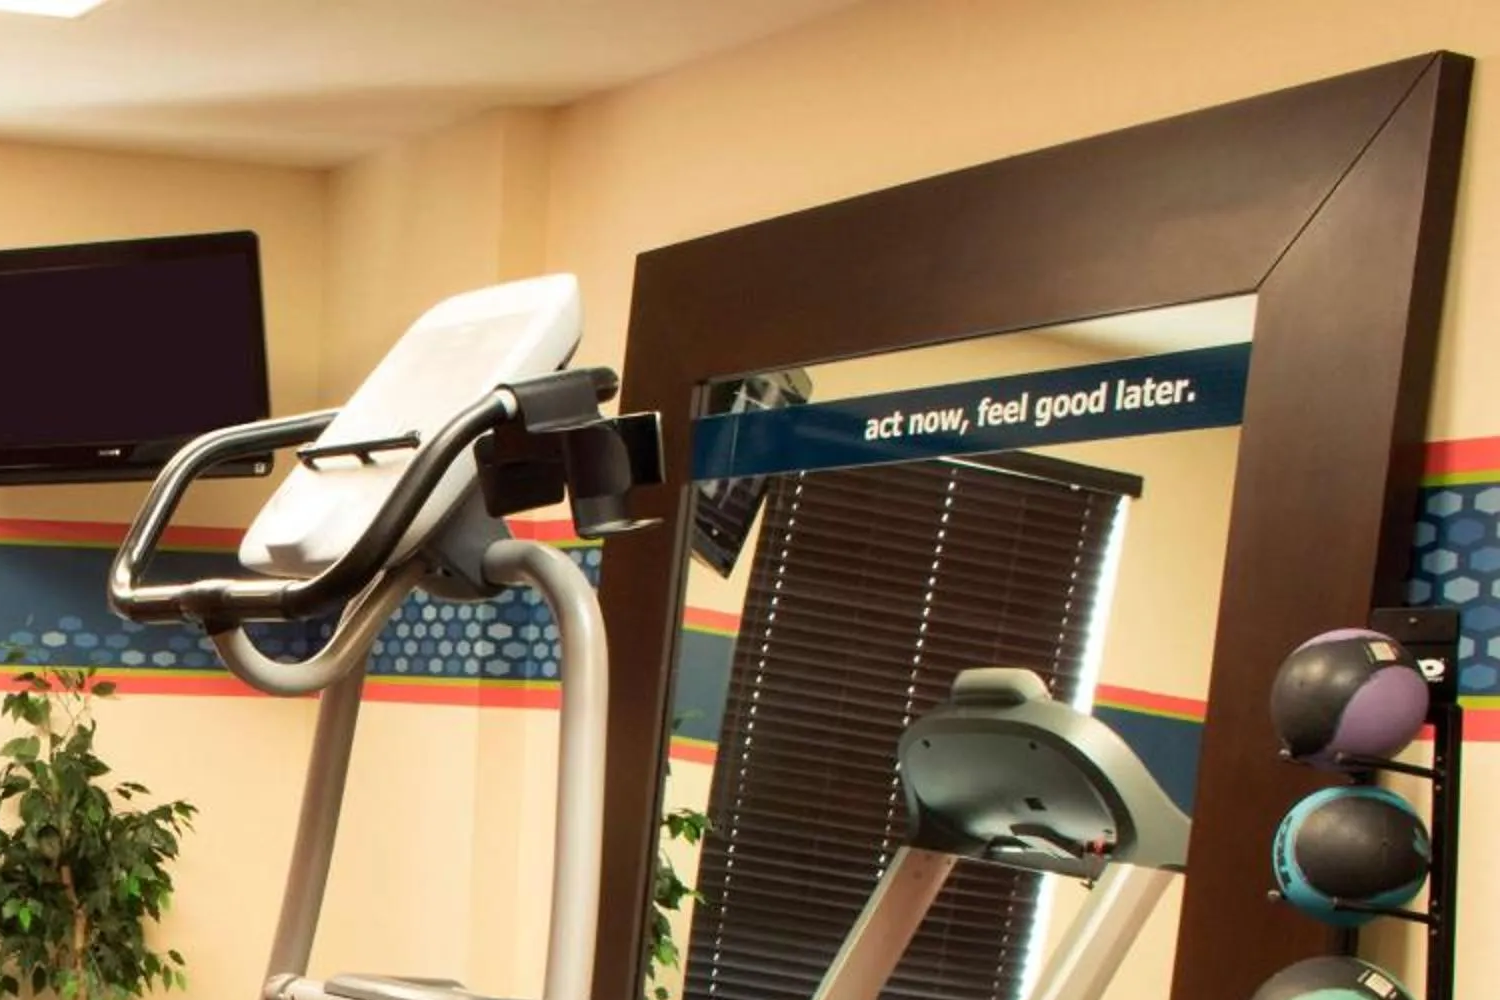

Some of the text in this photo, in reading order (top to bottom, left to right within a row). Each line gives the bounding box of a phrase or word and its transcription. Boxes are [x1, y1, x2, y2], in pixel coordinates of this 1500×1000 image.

[864, 378, 1197, 441] act now, feel good later.
